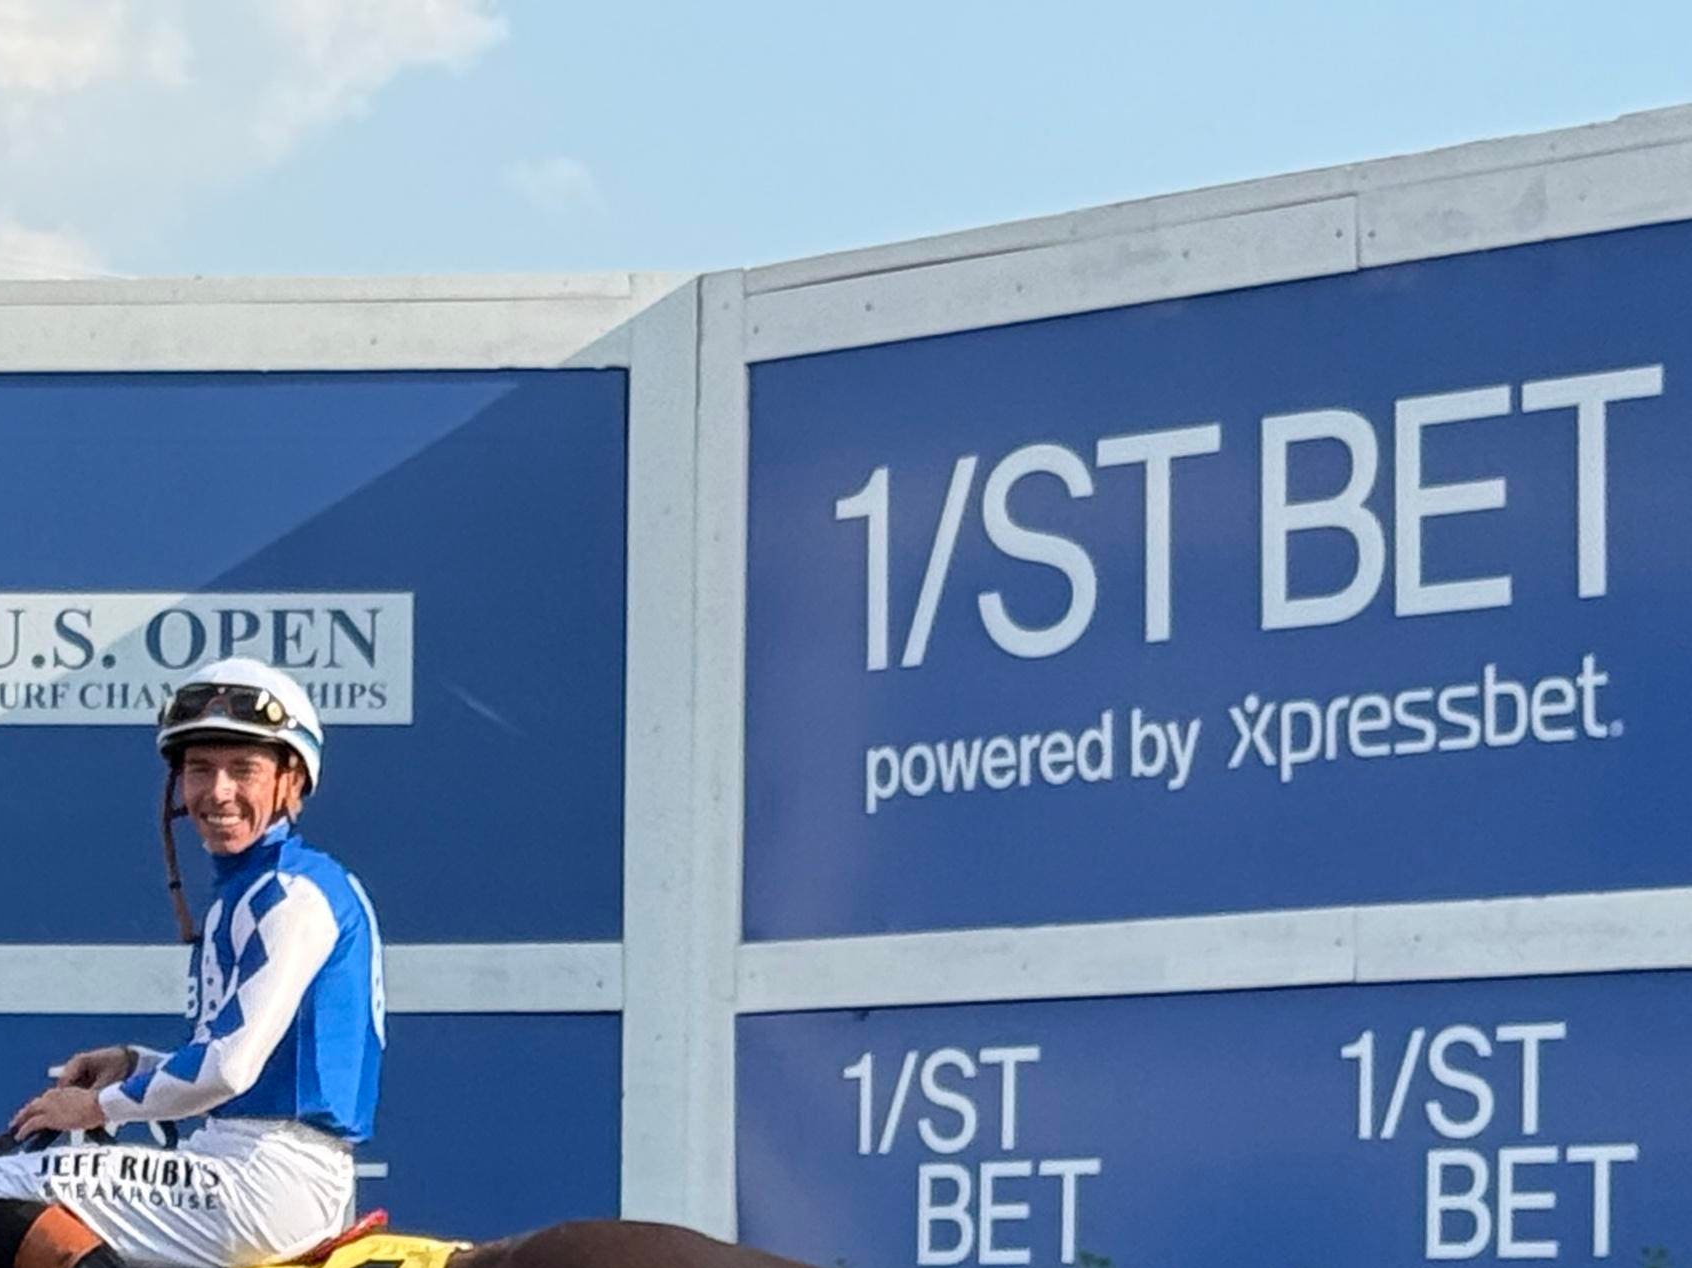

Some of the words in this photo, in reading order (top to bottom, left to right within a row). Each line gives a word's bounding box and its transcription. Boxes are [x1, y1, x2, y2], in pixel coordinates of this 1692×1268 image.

[835, 423, 1222, 671] 1/ST
[1261, 364, 1664, 631] BET
[146, 608, 383, 669] OPEN
[79, 682, 389, 710] CHAHIPS
[866, 709, 1114, 814] powered
[1131, 707, 1202, 790] by
[843, 1046, 1040, 1155] 1/ST
[1341, 1022, 1567, 1140] 1/ST
[35, 1151, 108, 1178] JEFF
[42, 1182, 218, 1211] STEAKHOUSE
[917, 1158, 1102, 1265] BET
[1426, 1143, 1639, 1259] BET
